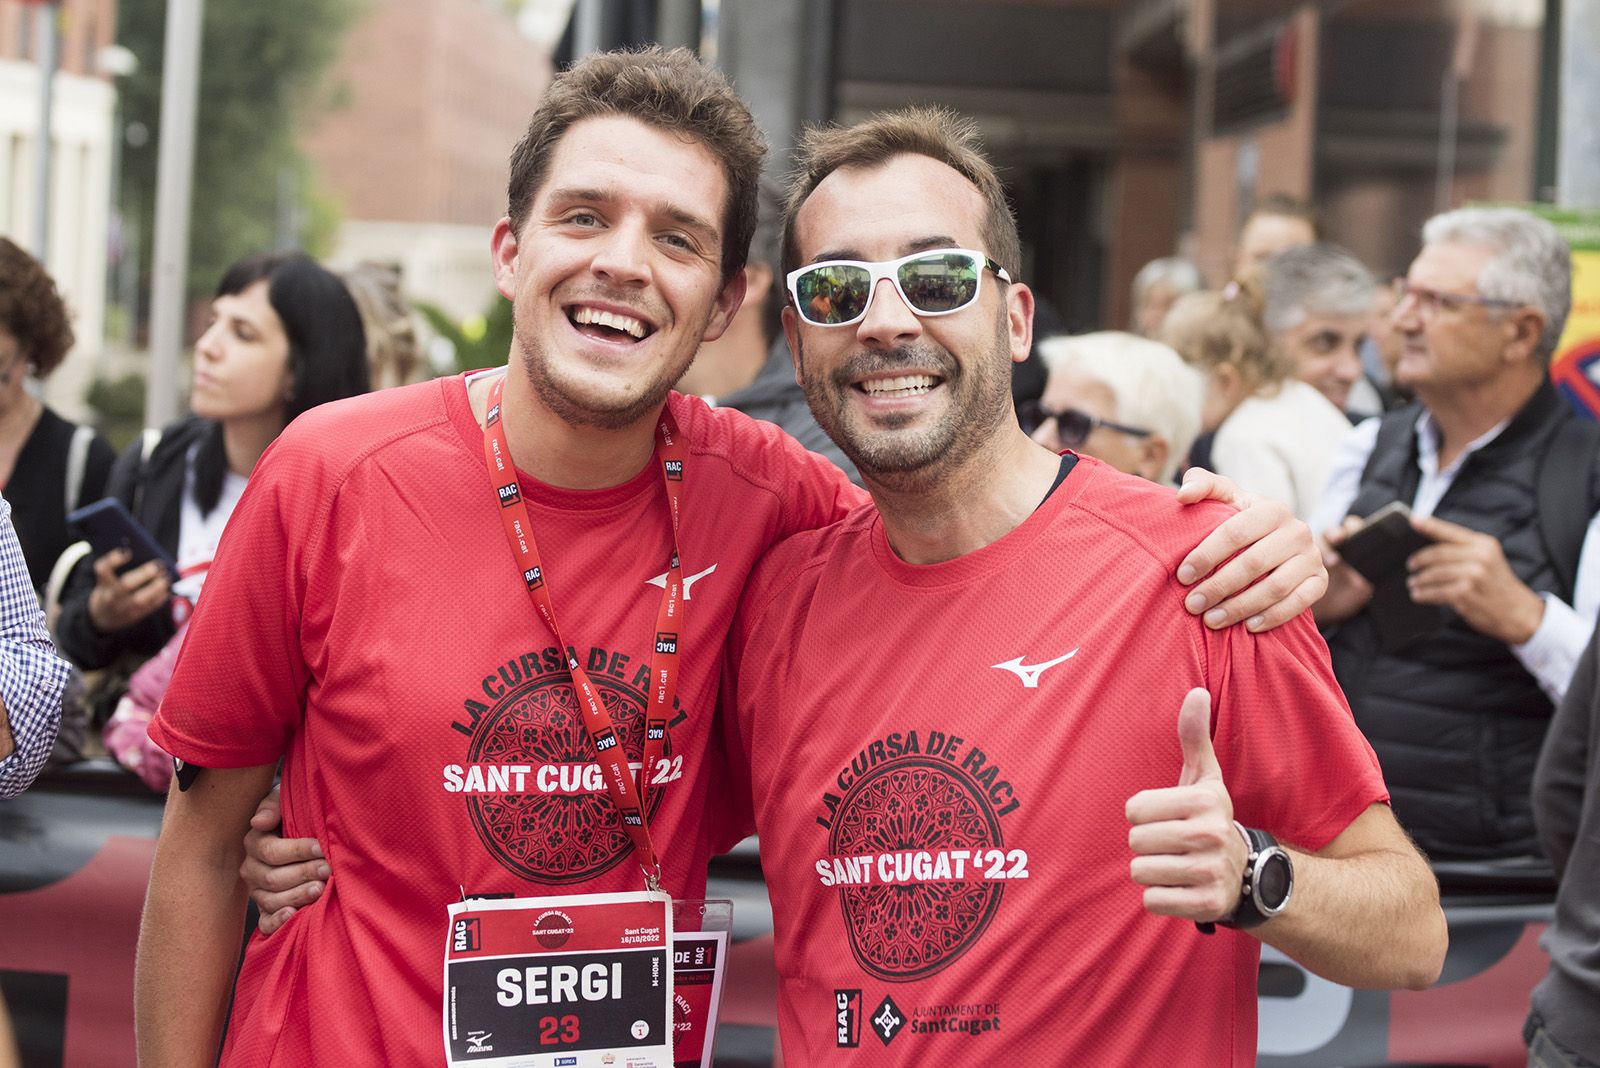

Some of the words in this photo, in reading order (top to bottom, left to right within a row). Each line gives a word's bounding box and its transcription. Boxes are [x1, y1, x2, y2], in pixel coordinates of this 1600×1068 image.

[491, 438, 505, 472] rac1.cat
[513, 519, 529, 555] rac1.cat
[667, 583, 677, 617] rac1.cat
[451, 698, 490, 737] LA
[481, 646, 577, 701] CURSA
[588, 647, 630, 678] DE
[581, 682, 599, 716] rac1.cat
[657, 669, 668, 704] rac1.cat
[443, 764, 531, 793] SANT
[537, 762, 643, 793] CUGT
[610, 762, 627, 795] rac1.cat
[816, 792, 841, 830] LA
[837, 730, 920, 791] CURSA
[926, 730, 964, 762] DE
[961, 747, 1020, 818] RAC1
[815, 855, 873, 887] SANT
[877, 850, 971, 883] CUGAT
[973, 848, 1029, 880] '22
[621, 935, 660, 944] 16/10/2022
[640, 927, 660, 935] Cugat
[674, 951, 690, 964] DE
[496, 962, 622, 1008] SERGI
[675, 995, 692, 1015] RAC1
[913, 1005, 982, 1017] AJUNTAMENT
[985, 1003, 1001, 1015] DE
[539, 1014, 580, 1045] 23
[911, 1017, 1001, 1036] SantCugat
